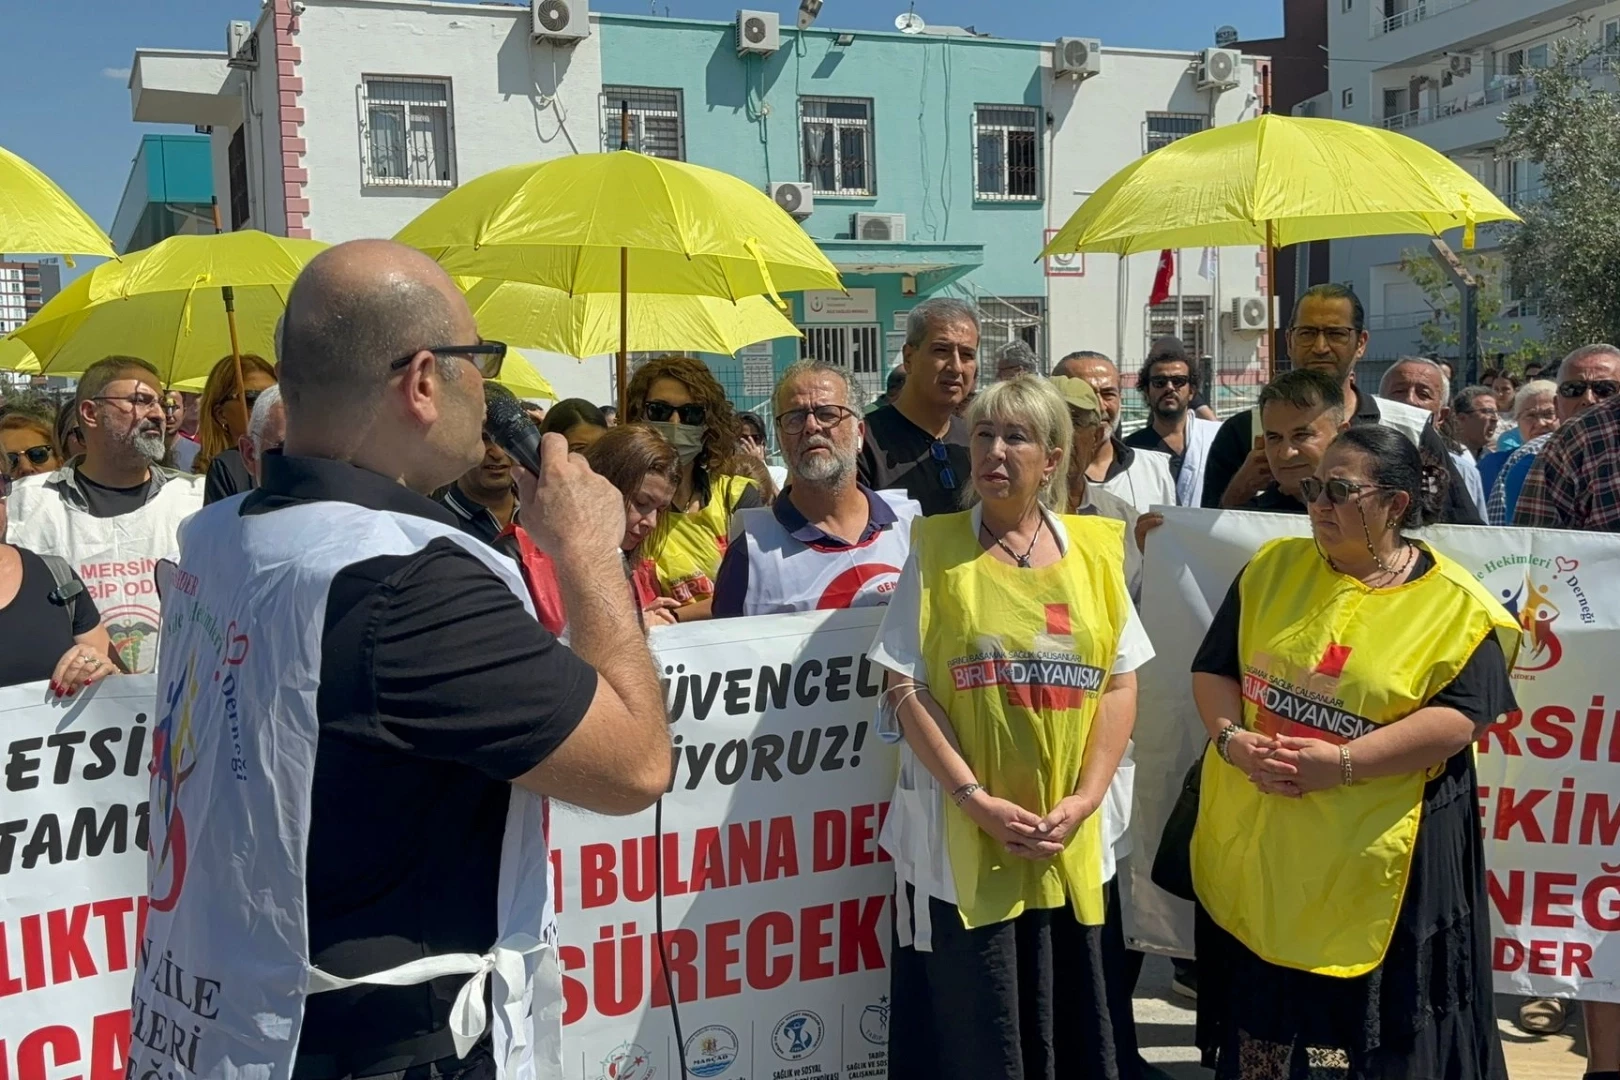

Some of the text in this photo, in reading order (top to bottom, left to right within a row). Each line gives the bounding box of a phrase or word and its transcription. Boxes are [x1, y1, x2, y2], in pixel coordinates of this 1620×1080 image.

[124, 579, 158, 597] OD
[1484, 554, 1552, 574] Hekimleri
[1566, 575, 1595, 625] Derneği
[663, 652, 889, 724] ÜVENCEL
[5, 712, 151, 792] ETSİ
[1478, 695, 1620, 763] RSİ
[580, 815, 799, 910] BULANA
[151, 950, 221, 1020] AİLE
[558, 894, 893, 1026] SÜRECEK
[1492, 937, 1594, 978] DER
[131, 985, 202, 1075] LERİ
[801, 1064, 822, 1076] SOSYAL
